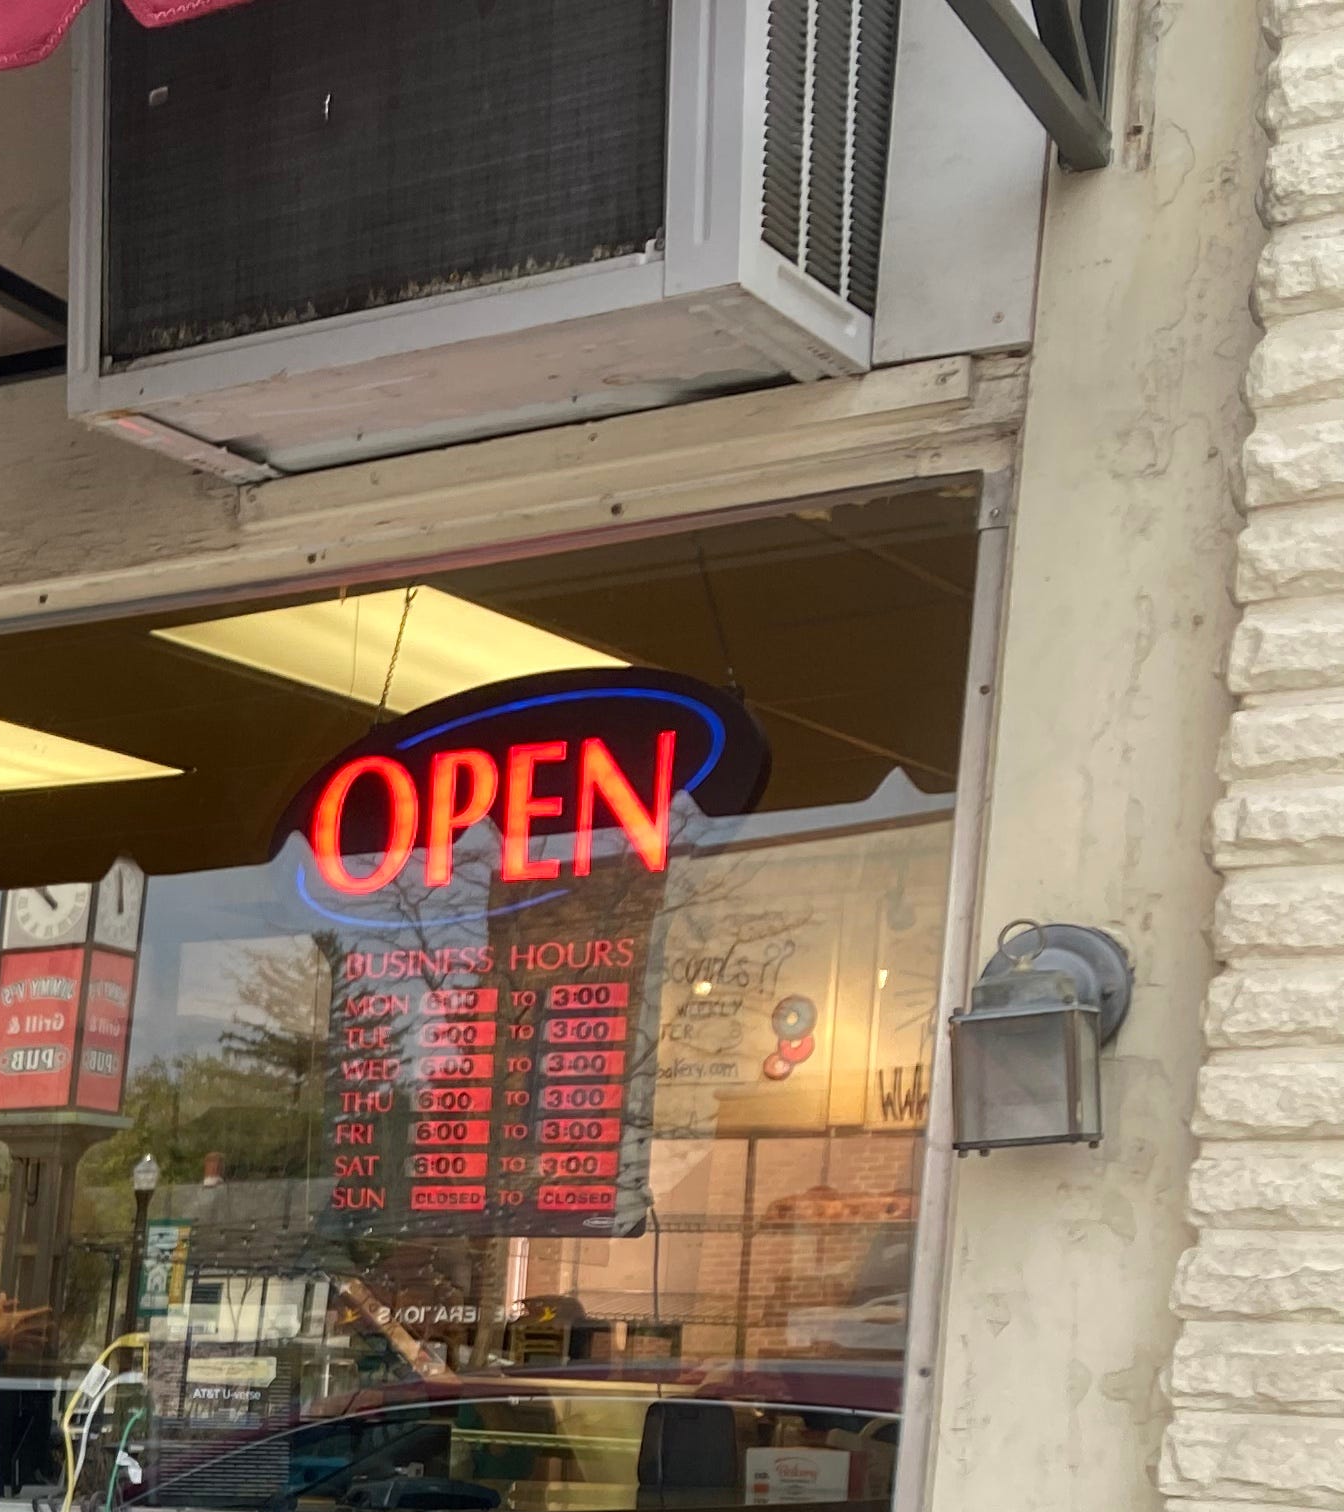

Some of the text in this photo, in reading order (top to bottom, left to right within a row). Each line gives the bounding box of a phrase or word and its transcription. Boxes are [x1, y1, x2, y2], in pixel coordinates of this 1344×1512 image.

[313, 730, 677, 895] OPEN
[346, 938, 635, 979] BUSINESS HOURS
[344, 994, 410, 1016] MON
[511, 991, 536, 1007] TO
[553, 986, 611, 1006] 3:00
[344, 1026, 392, 1049] TUE
[510, 1024, 534, 1040] TO
[552, 1020, 610, 1041] 3:00
[341, 1059, 401, 1081] WED
[507, 1056, 532, 1073] TO
[548, 1055, 606, 1074] 3:00
[340, 1088, 605, 1113] THU 6:00 TO 3:00
[336, 1121, 602, 1144] FRI 6:00 TO 3:00
[334, 1155, 598, 1177] SAT 6:00 TO 3:00
[332, 1188, 612, 1209] SUN CLOSED TO CLOSED
[193, 1388, 220, 1399] AT&T
